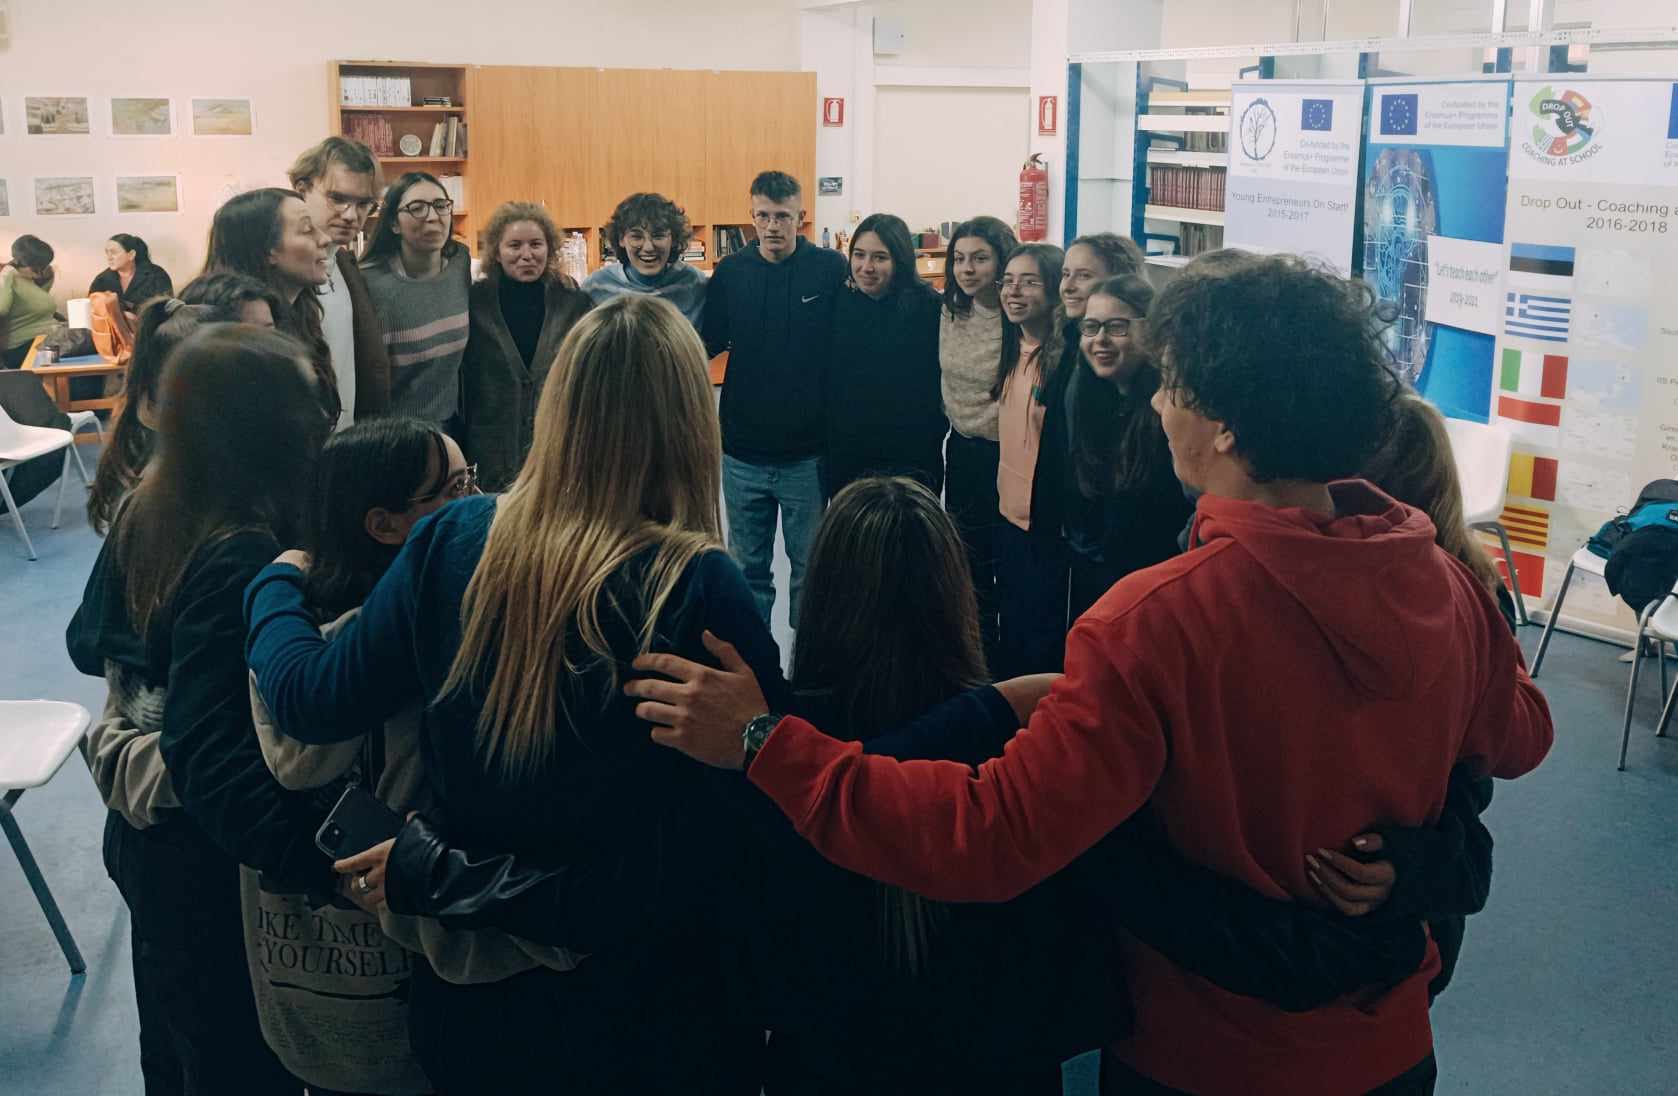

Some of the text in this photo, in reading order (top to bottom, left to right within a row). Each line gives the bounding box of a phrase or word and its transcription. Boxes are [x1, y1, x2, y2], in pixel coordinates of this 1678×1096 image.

[1542, 102, 1566, 112] DROP
[1563, 111, 1574, 128] OUT
[1557, 158, 1568, 167] AT
[1569, 143, 1603, 165] SCHOOL
[1231, 191, 1254, 205] Young
[1257, 192, 1311, 209] Entrepreneurs
[1313, 199, 1326, 209] On
[1520, 194, 1552, 212] Drop
[1556, 197, 1583, 210] Out
[1597, 199, 1669, 217] Coaching
[1267, 207, 1309, 220] 2015-2017
[1586, 216, 1668, 234] 2016-2018
